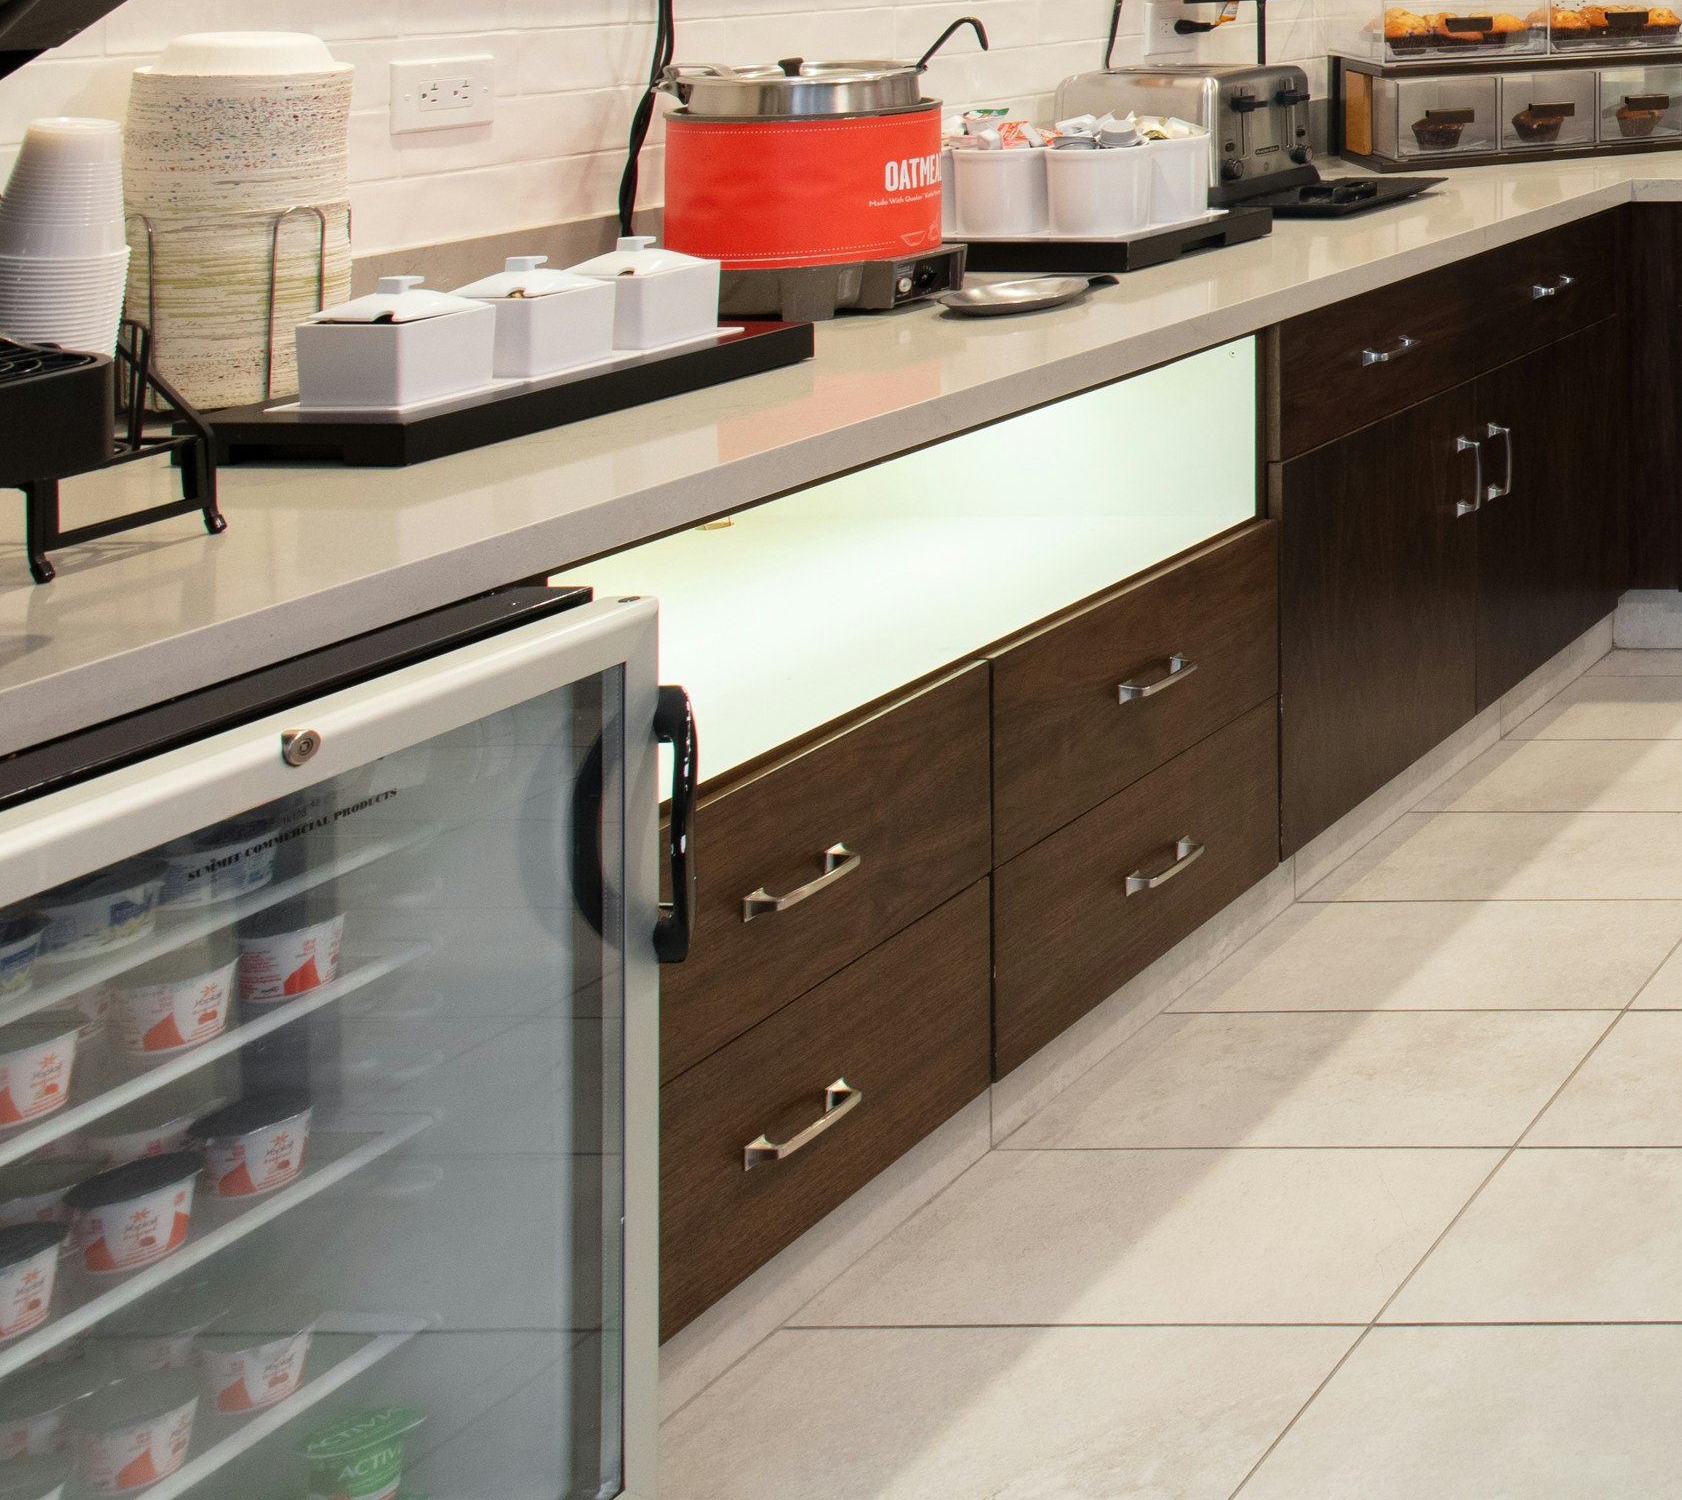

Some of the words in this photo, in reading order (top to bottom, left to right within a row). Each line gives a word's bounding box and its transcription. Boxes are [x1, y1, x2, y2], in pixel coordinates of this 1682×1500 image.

[187, 851, 242, 882] SUMMIT
[245, 815, 331, 857] COMMERCIAL
[334, 787, 398, 822] PRODUCTS
